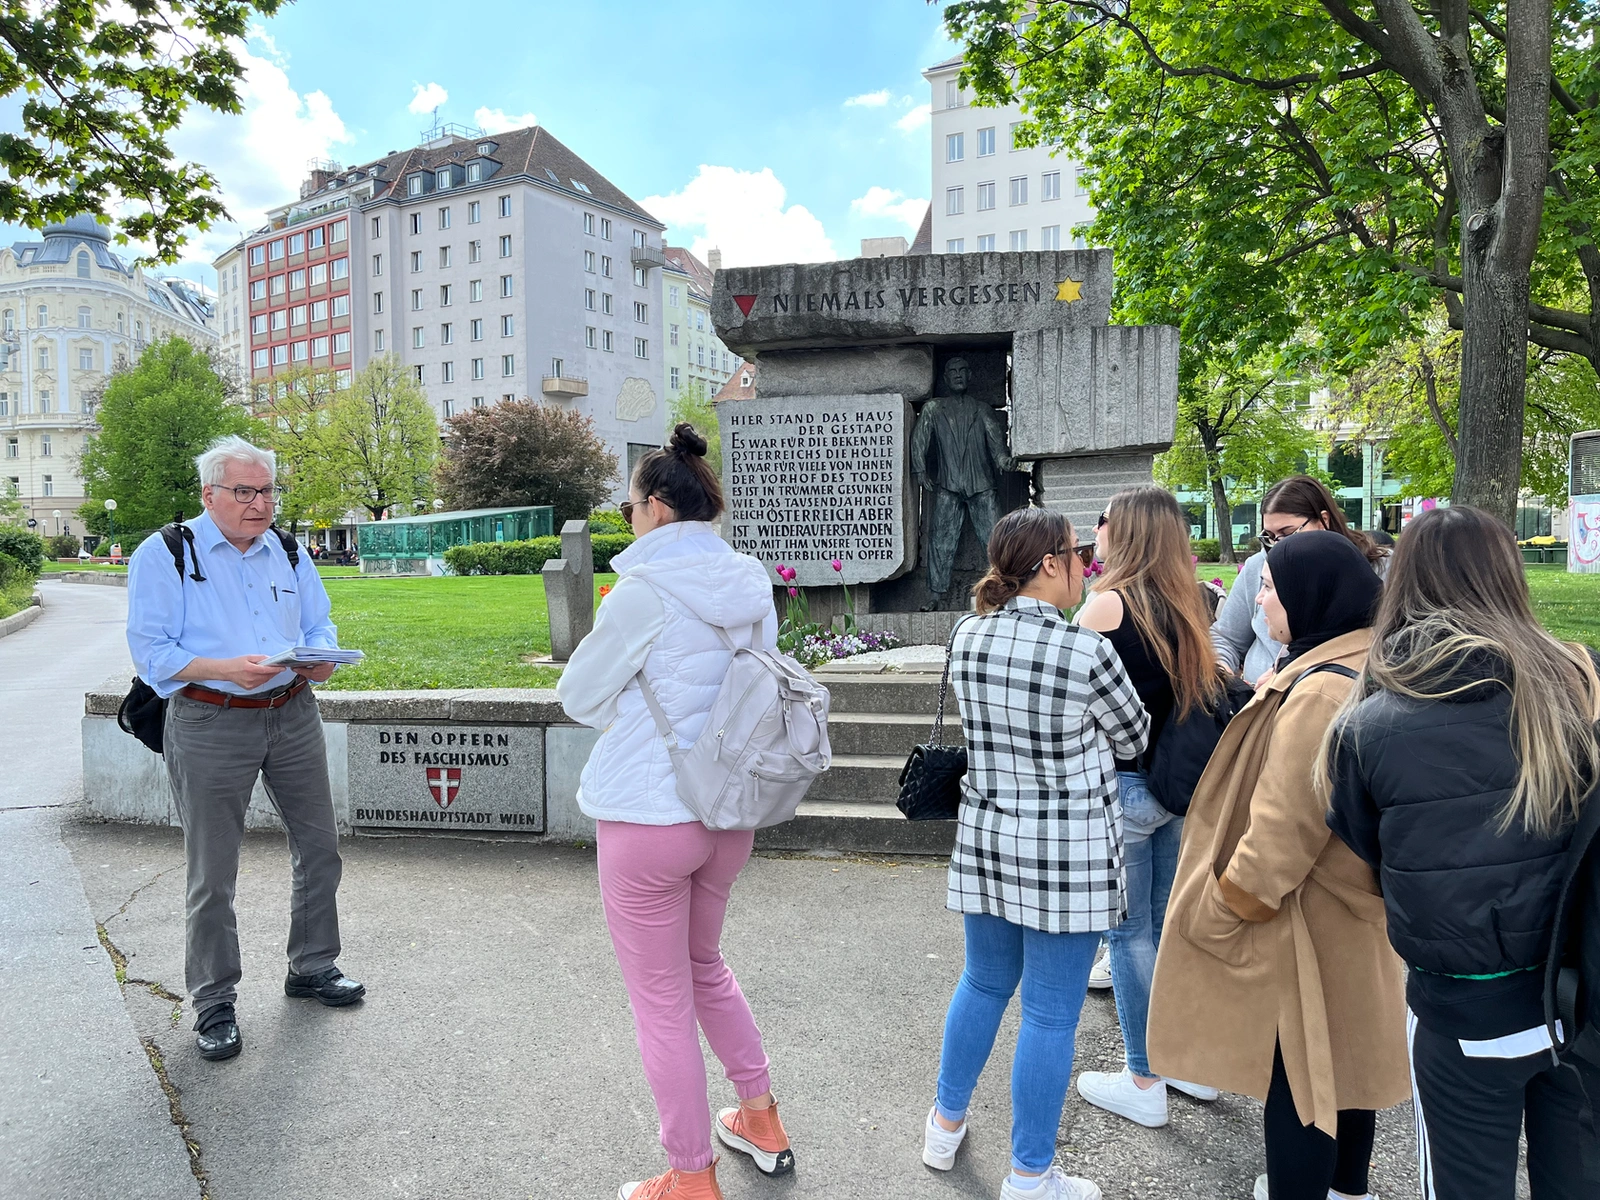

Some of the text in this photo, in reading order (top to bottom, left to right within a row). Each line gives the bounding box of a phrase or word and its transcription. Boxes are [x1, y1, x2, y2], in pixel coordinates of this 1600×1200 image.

[774, 282, 1041, 313] NIEMALS VERGESSEN
[731, 411, 893, 425] HIER STAND DAS HAUS
[799, 423, 893, 435] DER GESTAPO
[749, 439, 777, 448] WAR
[809, 437, 828, 447] DIE
[832, 435, 893, 446] BEKENNER
[826, 449, 847, 459] DIE
[745, 462, 771, 472] WAR
[798, 461, 826, 471] VIELE
[829, 460, 852, 471] VON
[857, 460, 893, 470] IHNEN
[732, 471, 893, 485] DER VORHOF DES TODES
[732, 486, 742, 496] ES
[745, 486, 759, 496] IST
[763, 486, 775, 496] IN
[838, 484, 893, 495] GESUNKEN
[732, 499, 754, 508] WIE
[759, 498, 781, 508] DAS
[732, 510, 764, 520] REICH
[858, 508, 893, 521] ABER
[732, 523, 893, 537] IST WIEDERAUFERSTANDEN
[732, 538, 893, 549] UND MIT IHM UNSERE TOTEN
[756, 550, 853, 561] UNSTERBLICHEN
[858, 549, 893, 560] OPFER
[380, 731, 509, 747] DEN OPFERN
[380, 751, 509, 767] DES FASCHISMUS
[356, 808, 535, 825] BUNDESHAUPTSTADT WIEN
